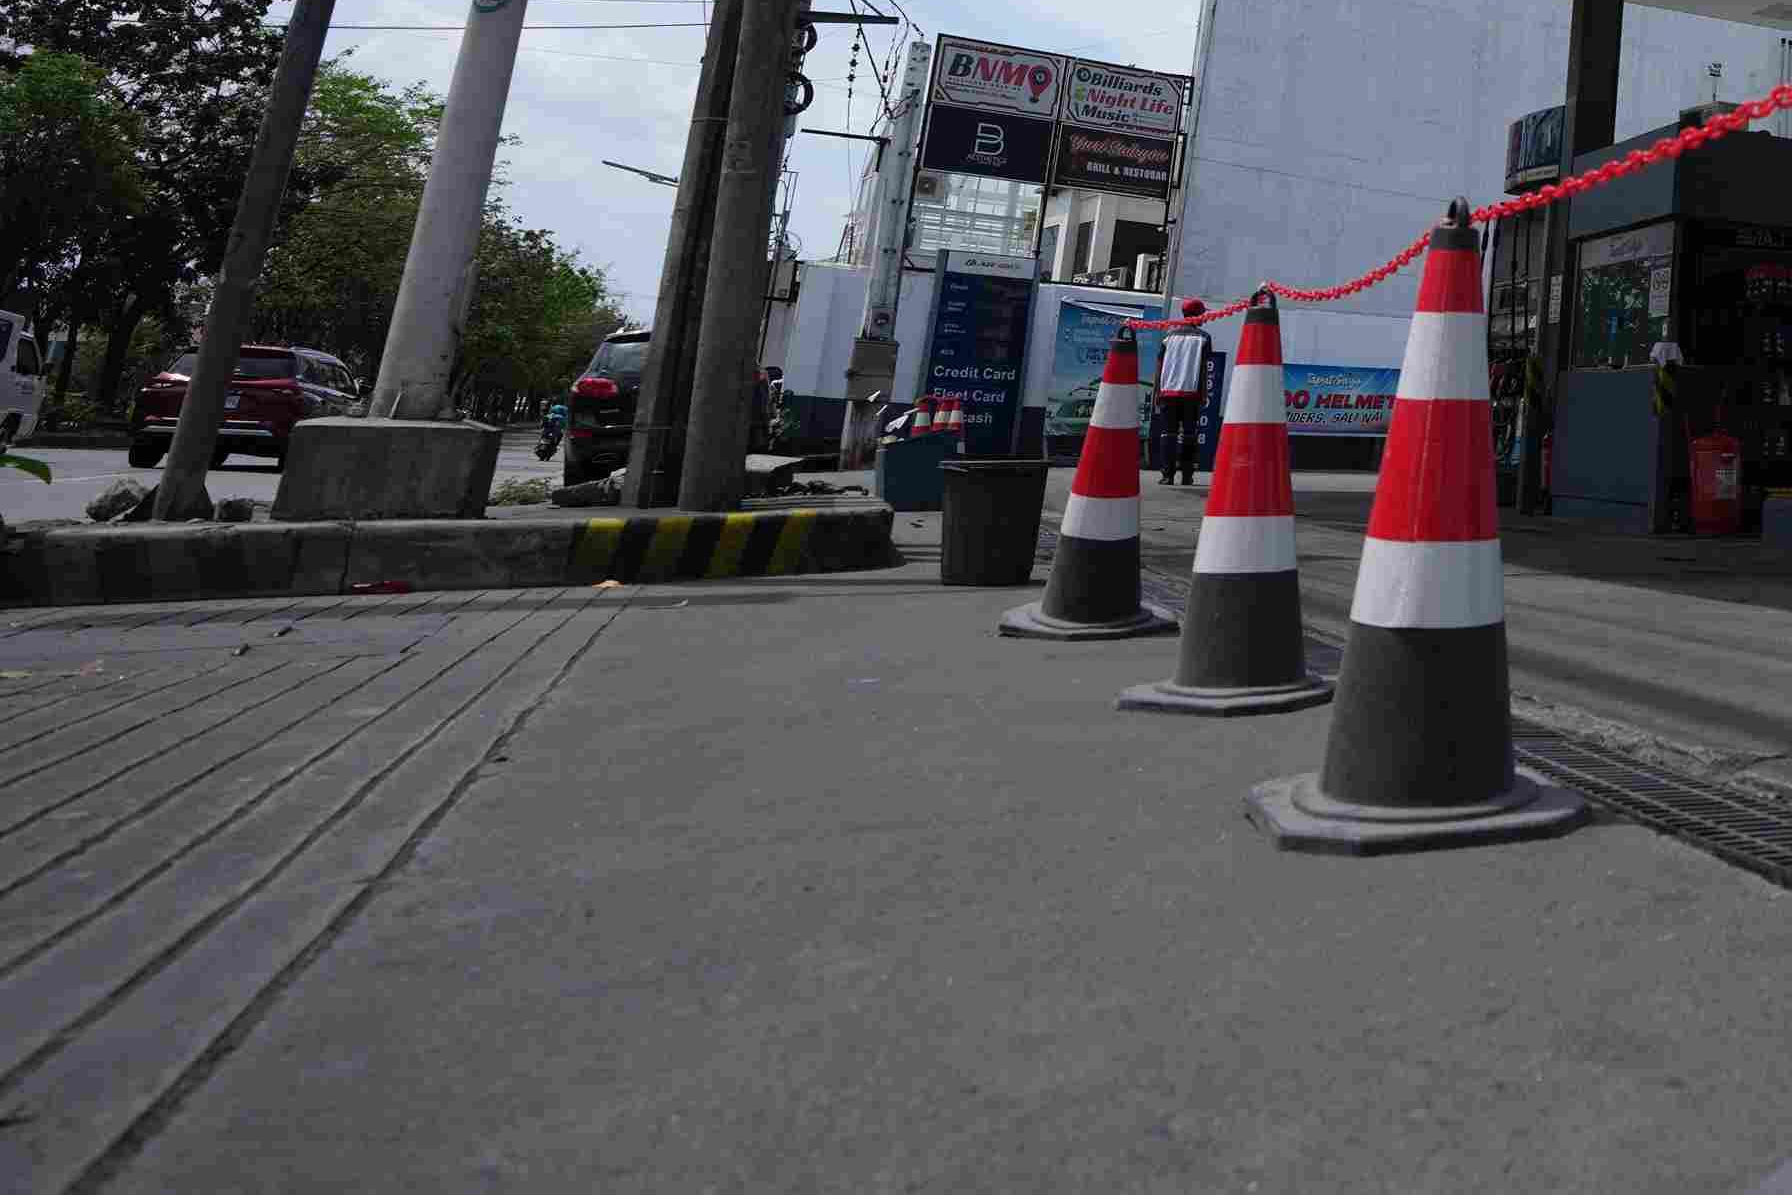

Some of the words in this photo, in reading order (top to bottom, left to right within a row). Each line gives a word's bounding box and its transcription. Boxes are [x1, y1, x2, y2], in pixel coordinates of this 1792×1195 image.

[1091, 71, 1163, 96] Billiards
[1087, 89, 1137, 109] Night
[1141, 97, 1173, 115] Life
[1081, 104, 1130, 122] Music
[1087, 161, 1111, 174] GRILL
[1122, 166, 1168, 182] RESTOBAR
[933, 365, 980, 379] Credit
[982, 367, 1016, 380] Card
[933, 387, 969, 400] Fleet
[972, 389, 1006, 403] Card
[1313, 393, 1397, 410] HELMET
[961, 411, 993, 424] cash
